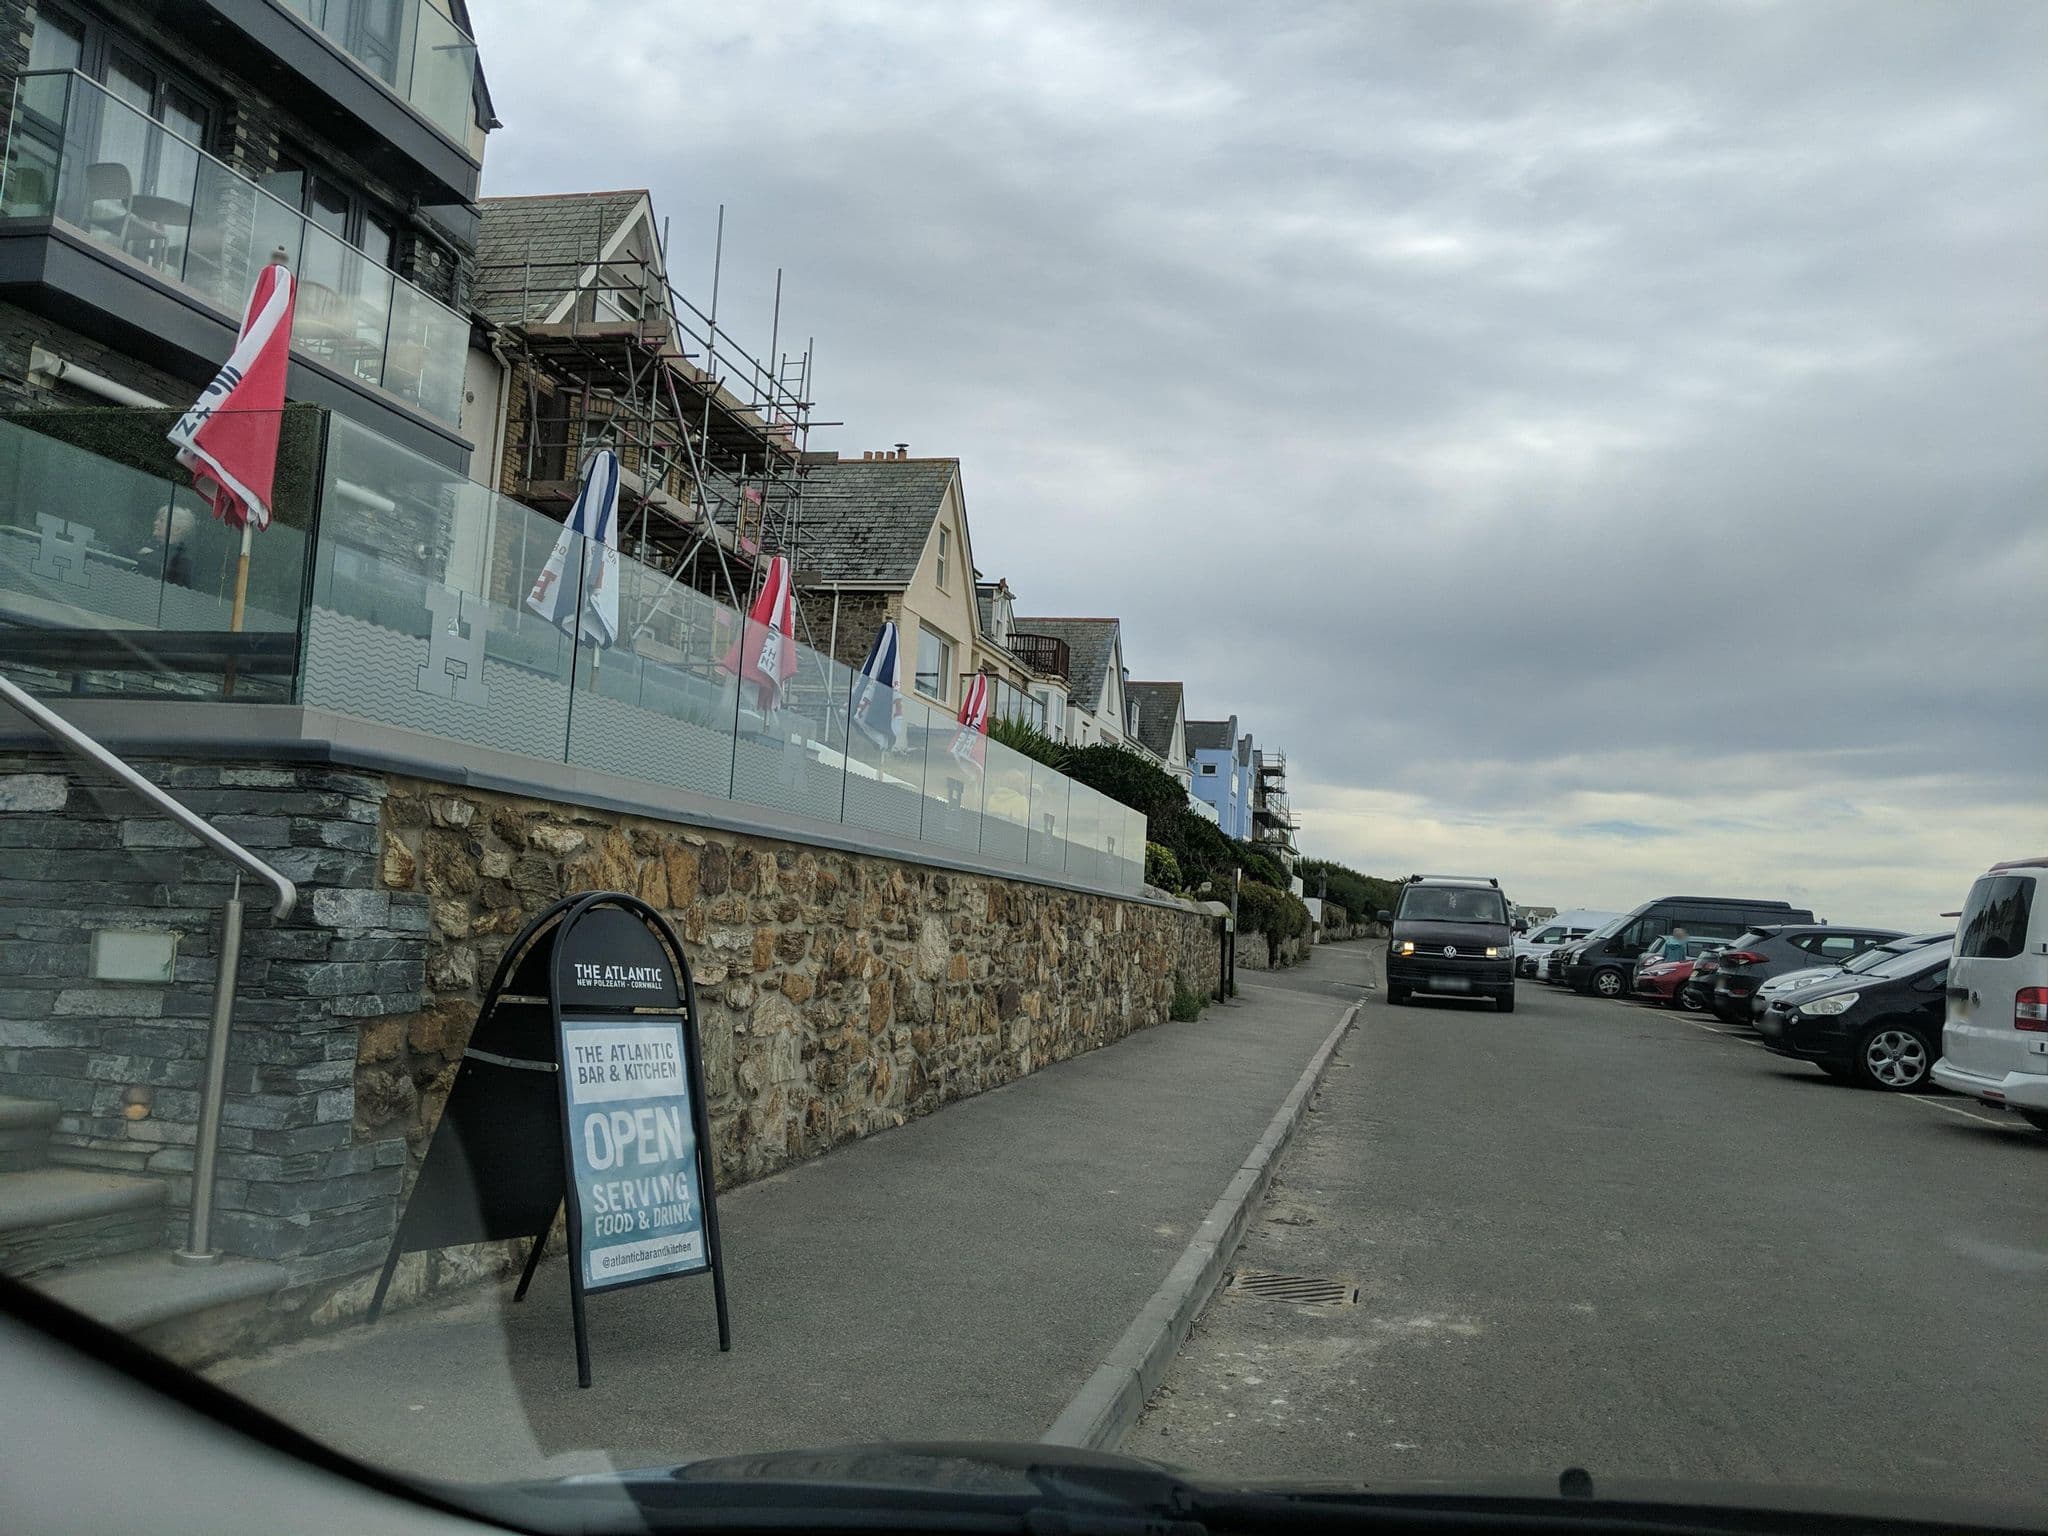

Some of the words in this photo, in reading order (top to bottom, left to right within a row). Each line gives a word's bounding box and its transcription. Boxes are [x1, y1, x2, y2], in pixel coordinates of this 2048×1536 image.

[574, 963, 601, 979] THE
[604, 965, 662, 981] ATLANTIC
[577, 979, 592, 987] NEW
[594, 979, 625, 988] POLZEATH
[631, 982, 662, 990] CORNWALL
[575, 1045, 603, 1063] THE
[610, 1042, 673, 1061] ATLANTIC
[578, 1066, 605, 1084] BAR
[610, 1064, 620, 1082] &
[624, 1061, 676, 1080] KITCHEN
[584, 1105, 684, 1171] OPEN
[592, 1172, 689, 1213] SERVING
[595, 1214, 633, 1237] FOOD
[639, 1210, 649, 1230] &
[654, 1202, 693, 1228] DRINK
[602, 1241, 692, 1269] @atlanticbarandkitchen
